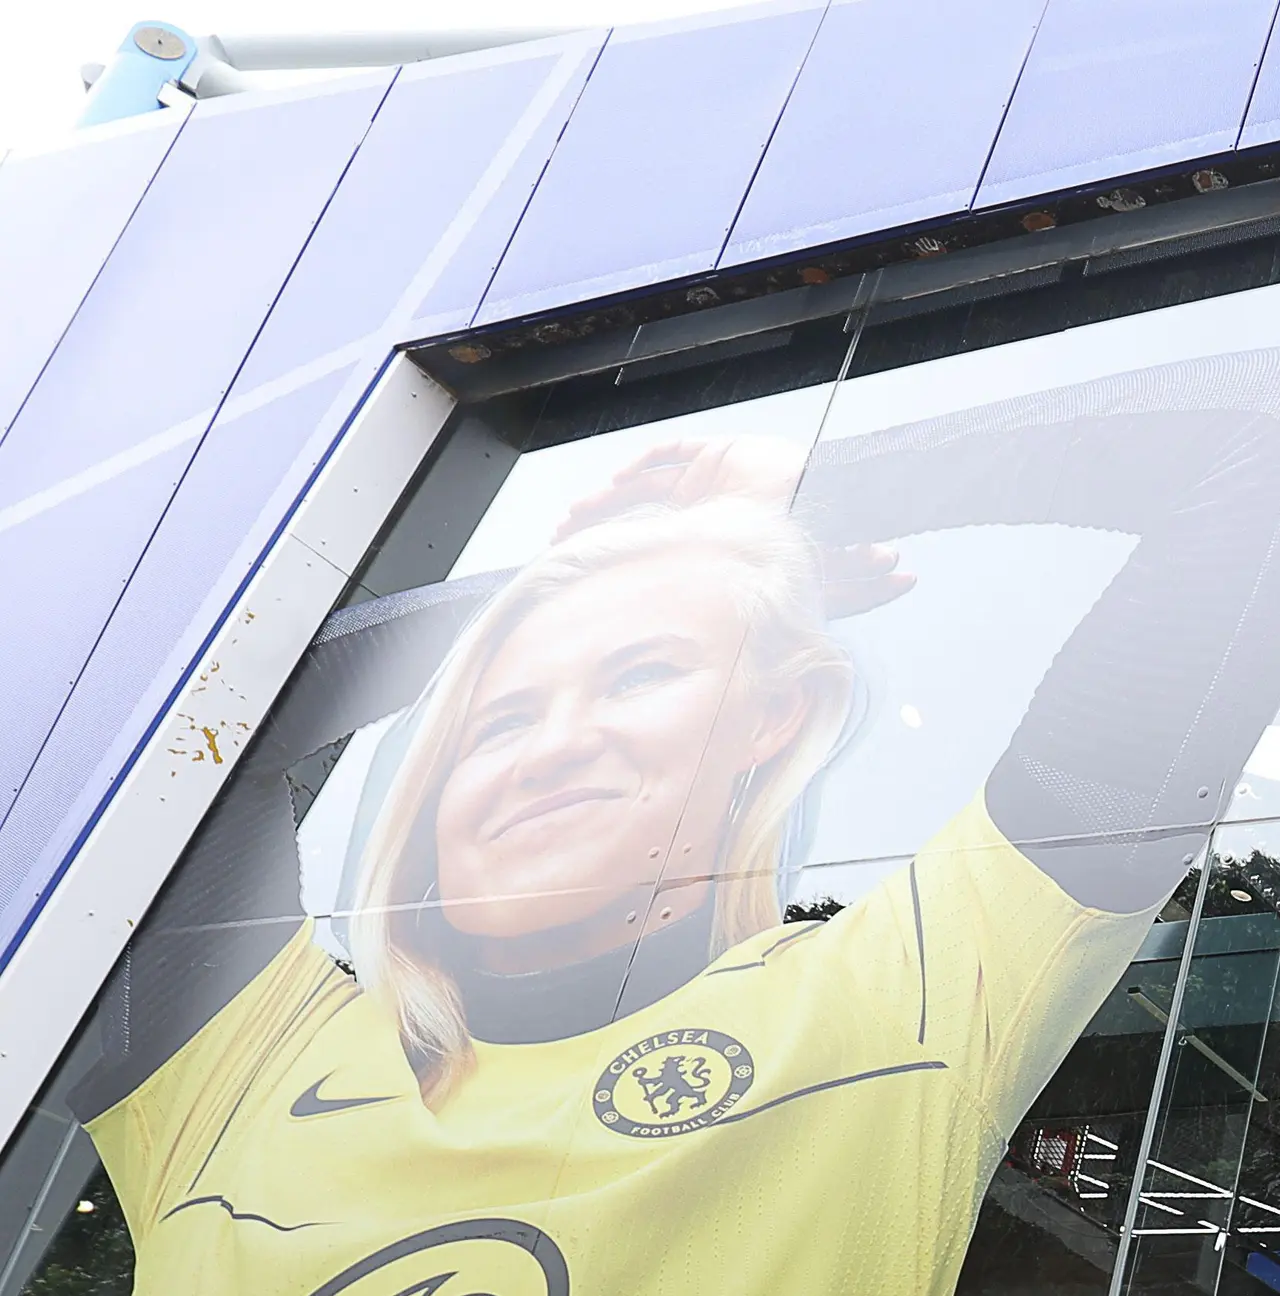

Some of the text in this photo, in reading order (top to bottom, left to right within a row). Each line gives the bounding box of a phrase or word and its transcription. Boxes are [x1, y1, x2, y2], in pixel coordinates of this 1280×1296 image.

[610, 1030, 709, 1074] CHELSEA
[630, 1092, 741, 1136] FOOTBALL CLUB
